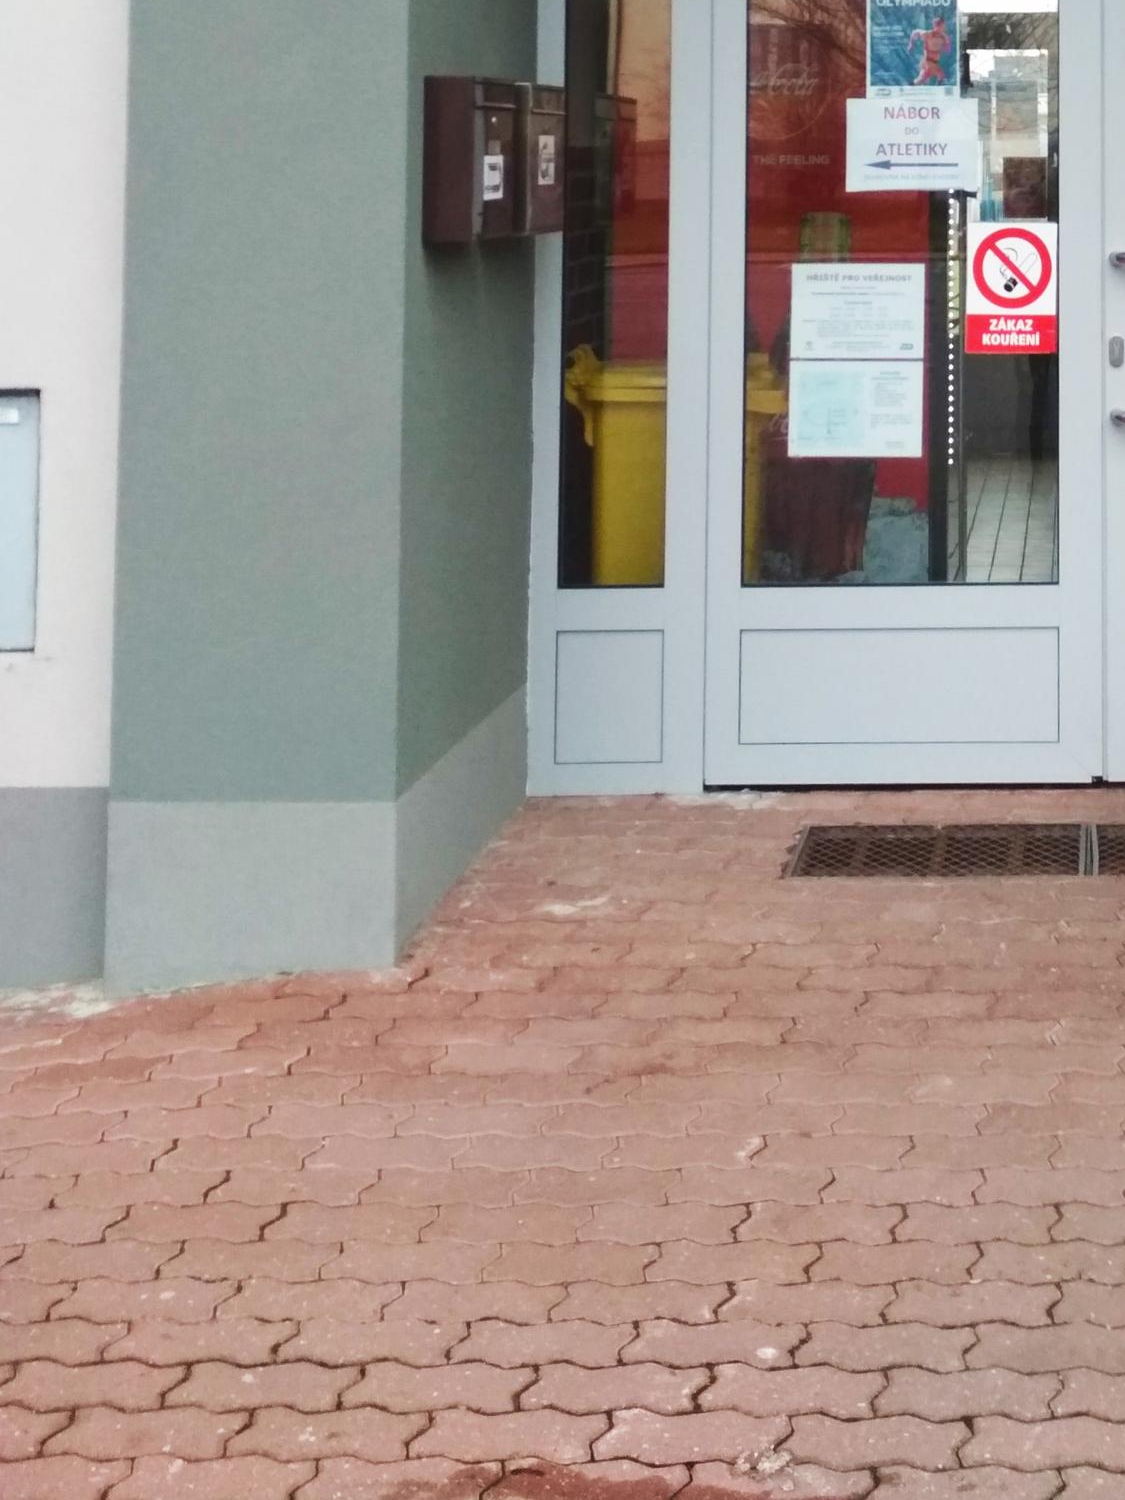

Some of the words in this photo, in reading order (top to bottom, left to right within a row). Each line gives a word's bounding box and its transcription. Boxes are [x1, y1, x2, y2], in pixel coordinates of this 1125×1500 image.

[883, 103, 941, 120] NÁBOR
[904, 127, 920, 136] DO
[875, 143, 949, 156] ATLETIKY
[842, 274, 860, 282] PRO
[862, 272, 912, 282] VEŘEJNOST
[988, 316, 1034, 332] ZÁKAZ
[981, 332, 1041, 347] KOUŘENÍ
